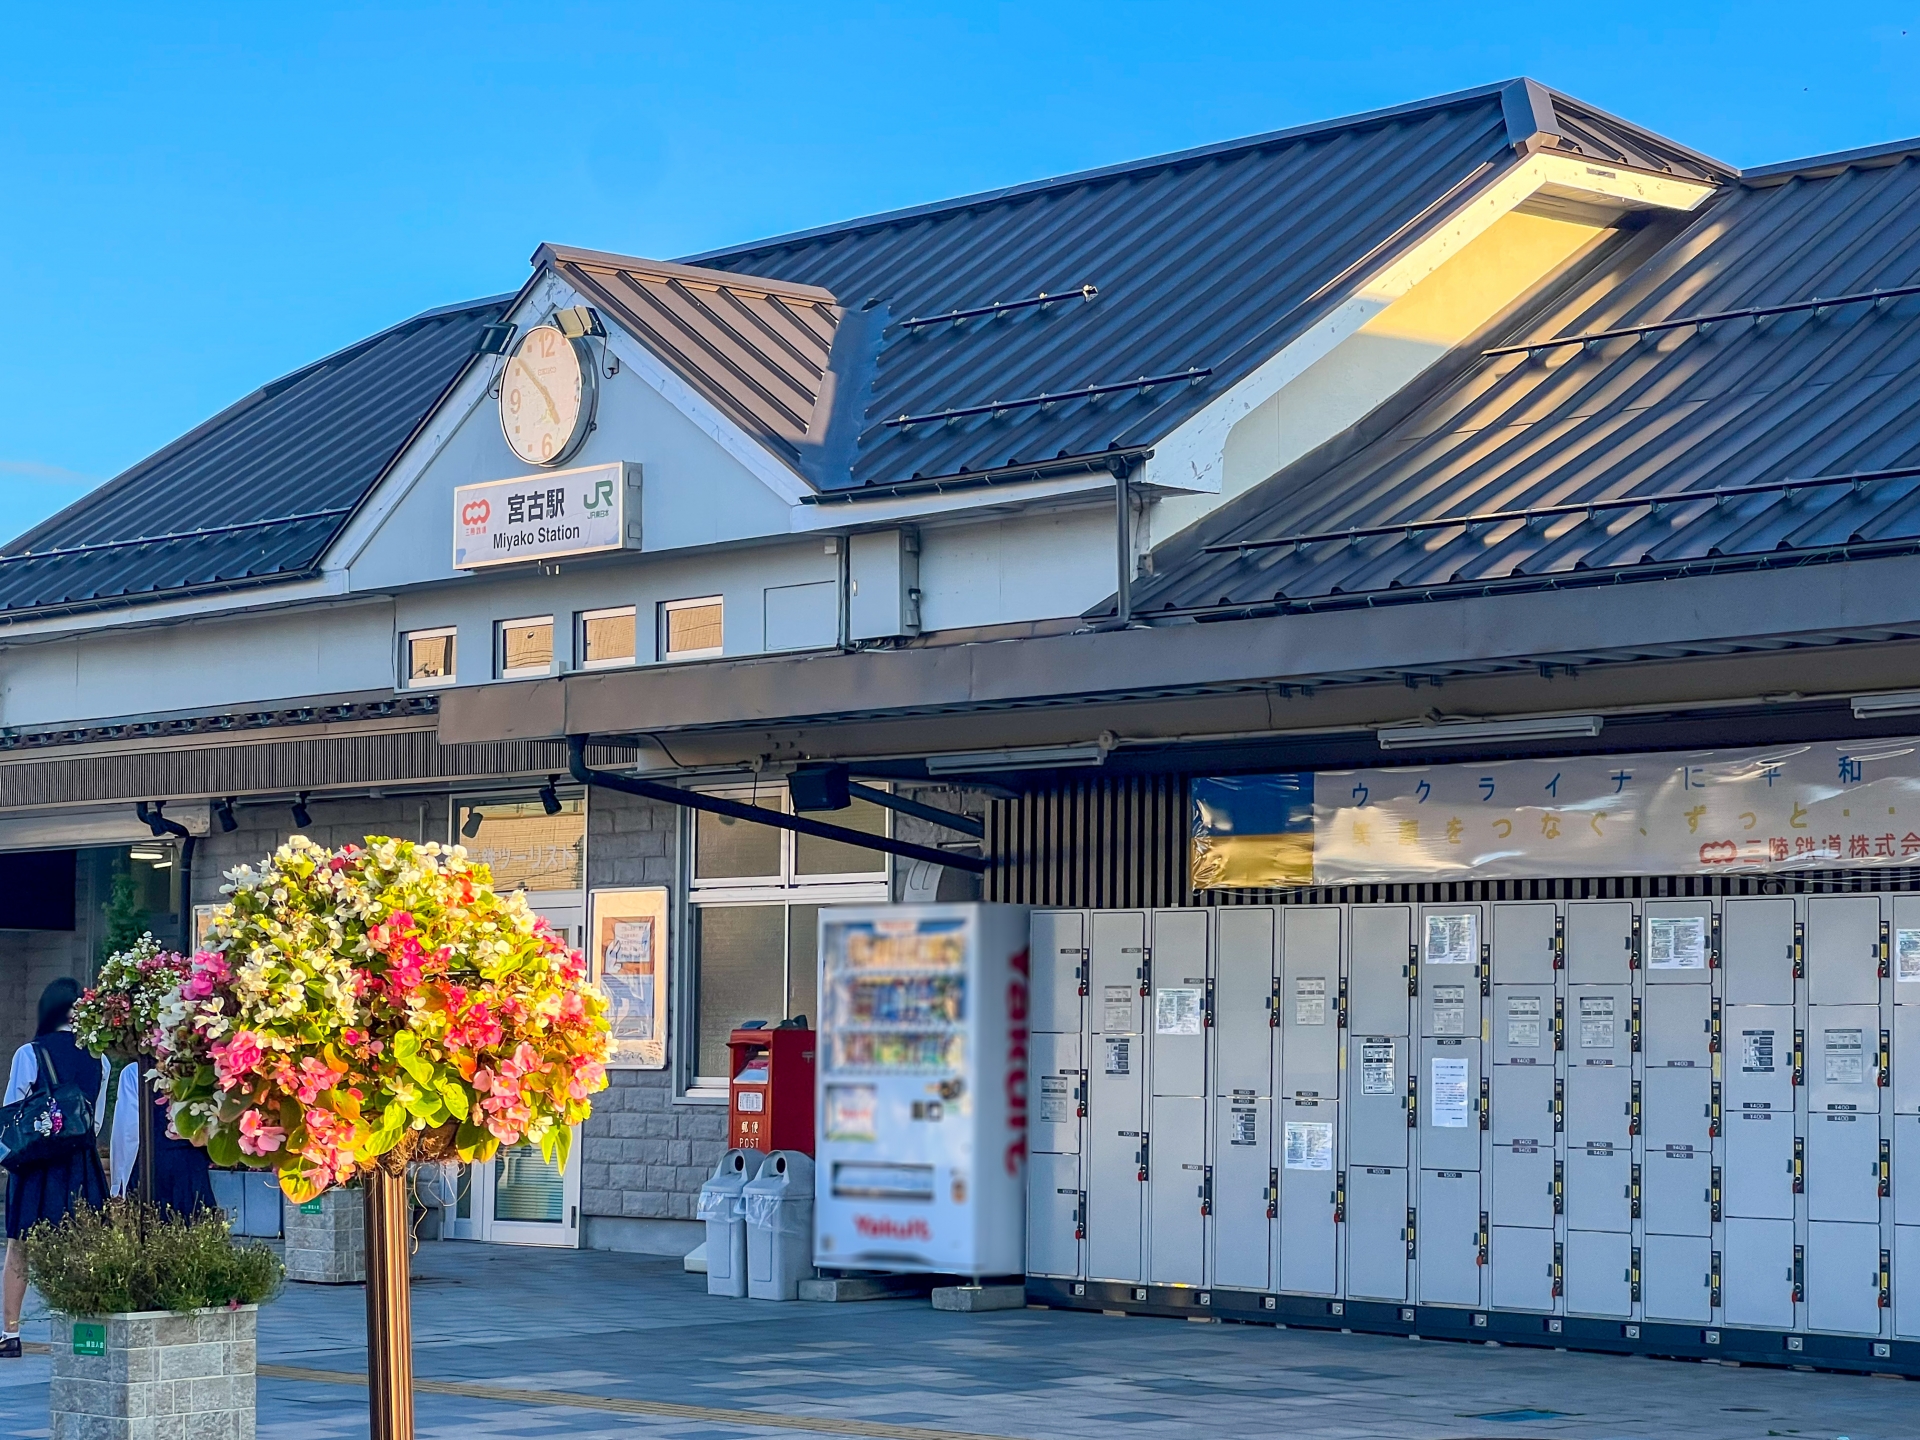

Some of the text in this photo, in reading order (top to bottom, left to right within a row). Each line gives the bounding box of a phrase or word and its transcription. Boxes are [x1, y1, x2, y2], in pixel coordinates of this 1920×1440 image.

[539, 331, 555, 358] 12
[510, 388, 521, 414] 9
[542, 433, 553, 459] 6
[507, 487, 565, 525] 宮古駅
[583, 480, 613, 509] JR
[493, 525, 580, 552] Miyako Station
[1352, 755, 1920, 807] ウクライナに平和
[741, 1121, 759, 1134] 郵便
[739, 1137, 760, 1149] POST
